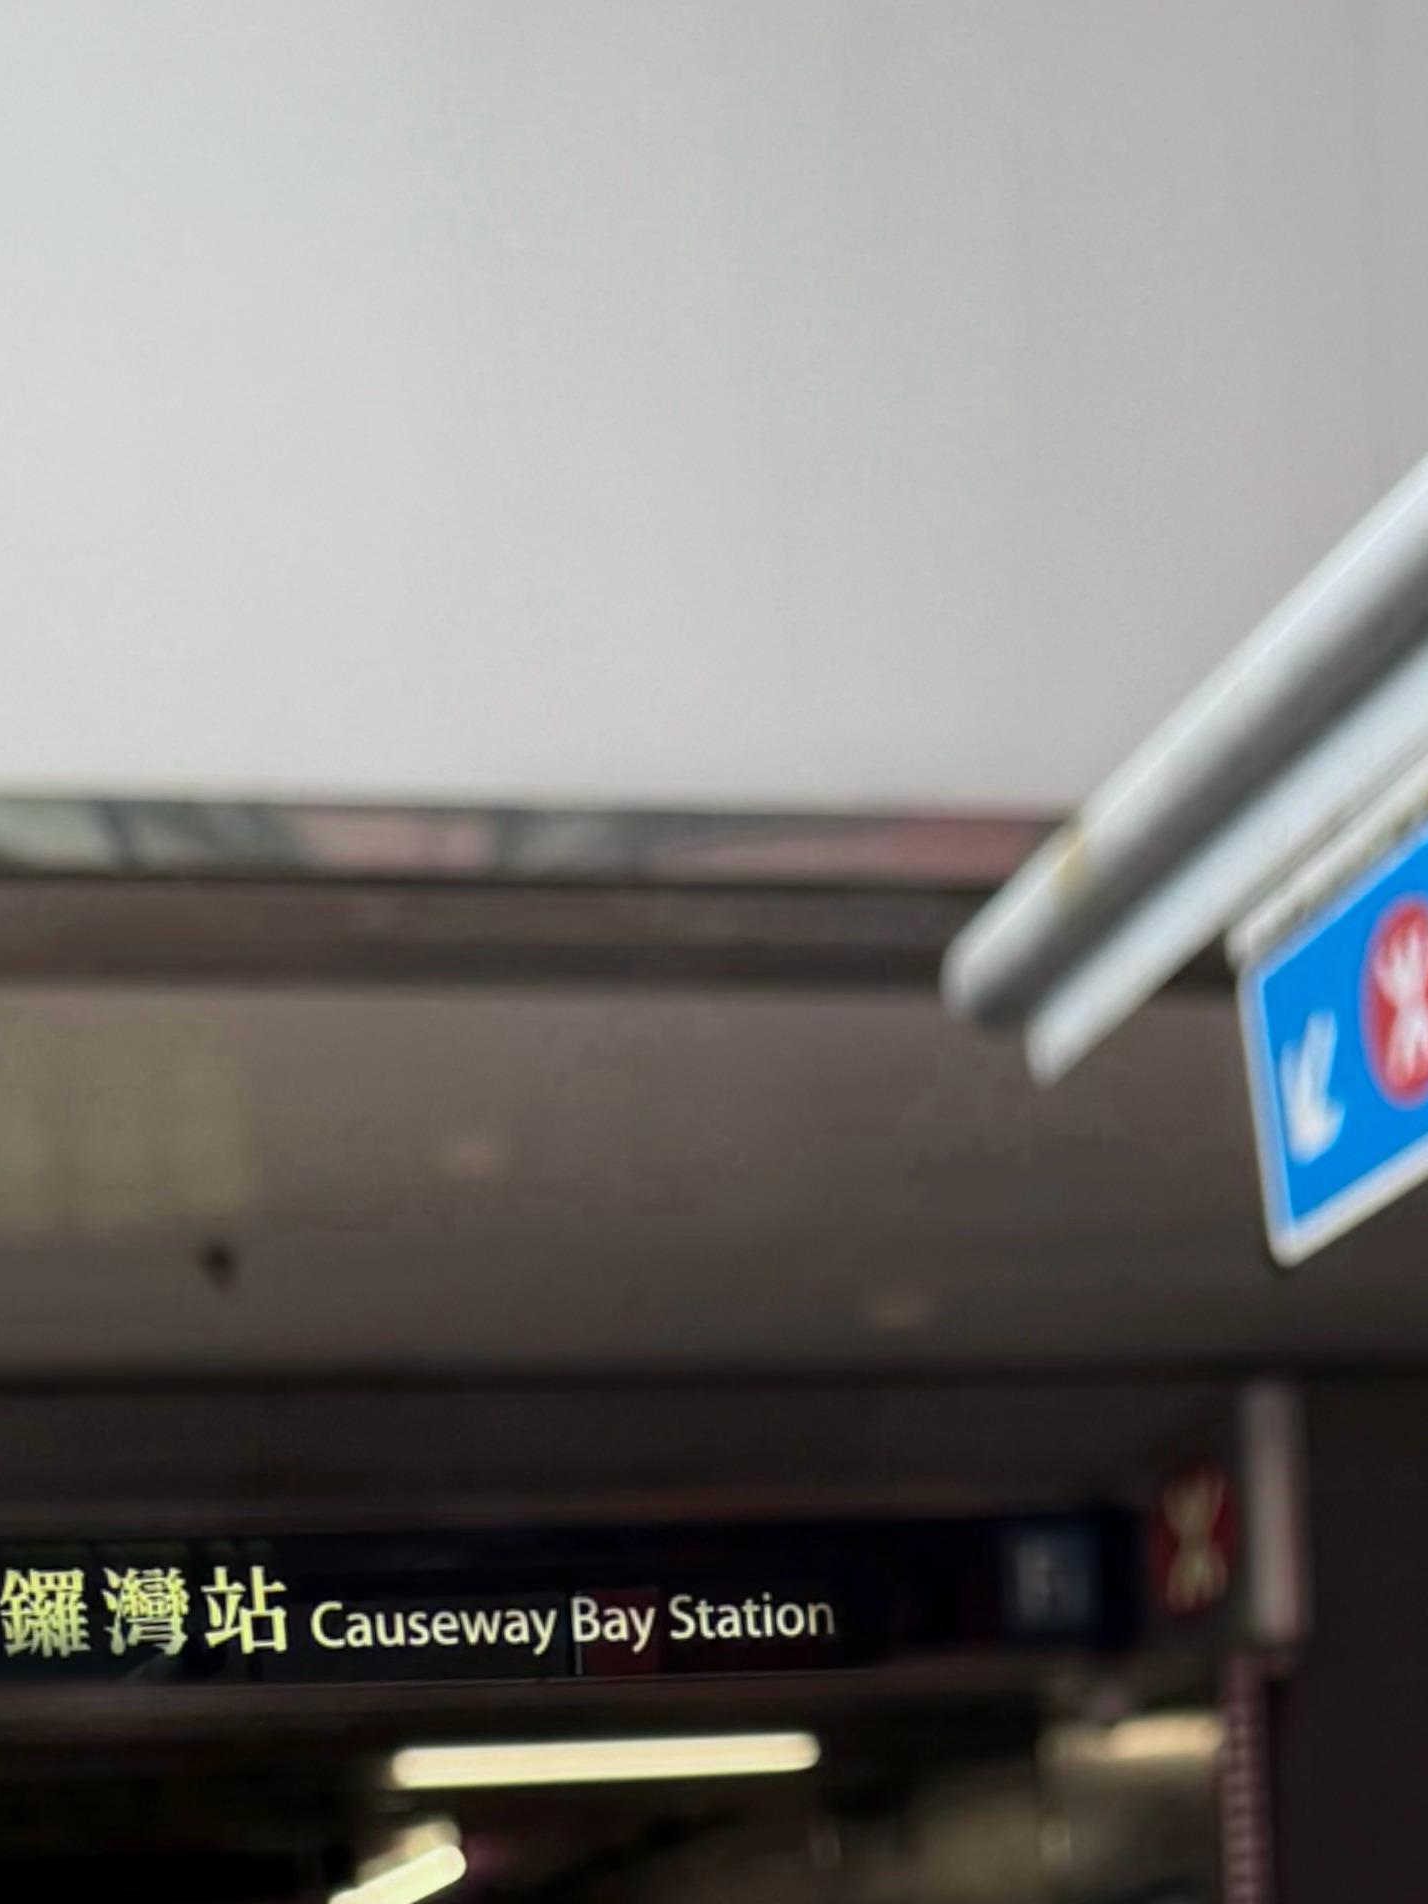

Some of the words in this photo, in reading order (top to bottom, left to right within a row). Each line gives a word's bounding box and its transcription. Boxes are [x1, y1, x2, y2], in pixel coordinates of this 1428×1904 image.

[310, 1601, 557, 1655] Causeway
[572, 1597, 655, 1652] Bay
[669, 1592, 835, 1640] Station
